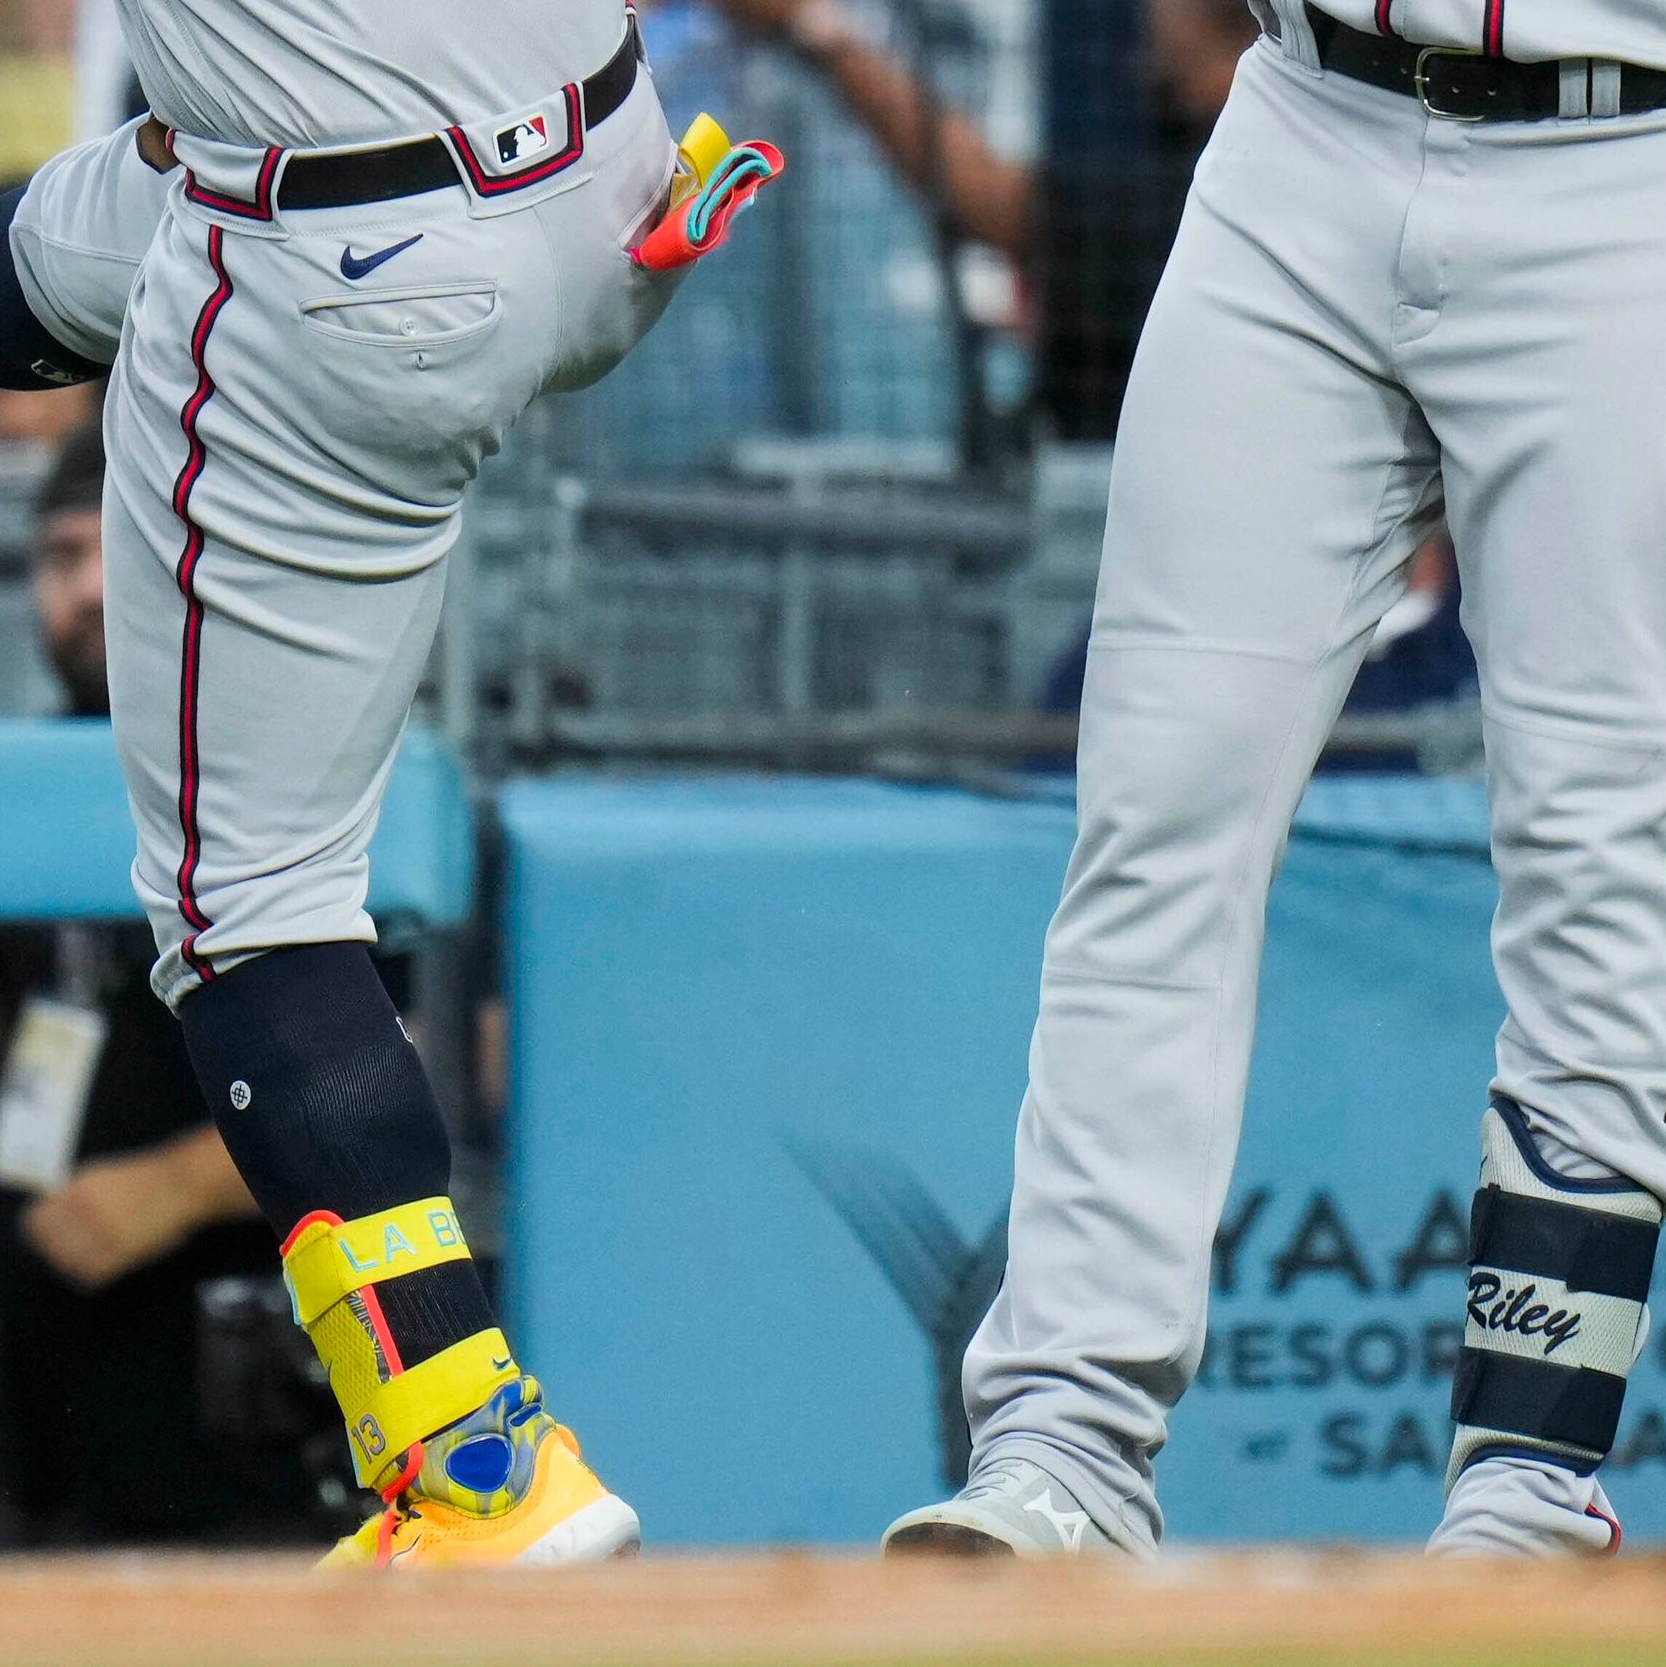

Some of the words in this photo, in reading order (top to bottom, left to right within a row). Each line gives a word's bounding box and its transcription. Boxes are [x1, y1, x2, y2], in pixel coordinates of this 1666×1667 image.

[339, 1224, 417, 1272] LA
[1467, 1272, 1581, 1355] Riley
[351, 1413, 386, 1464] 13
